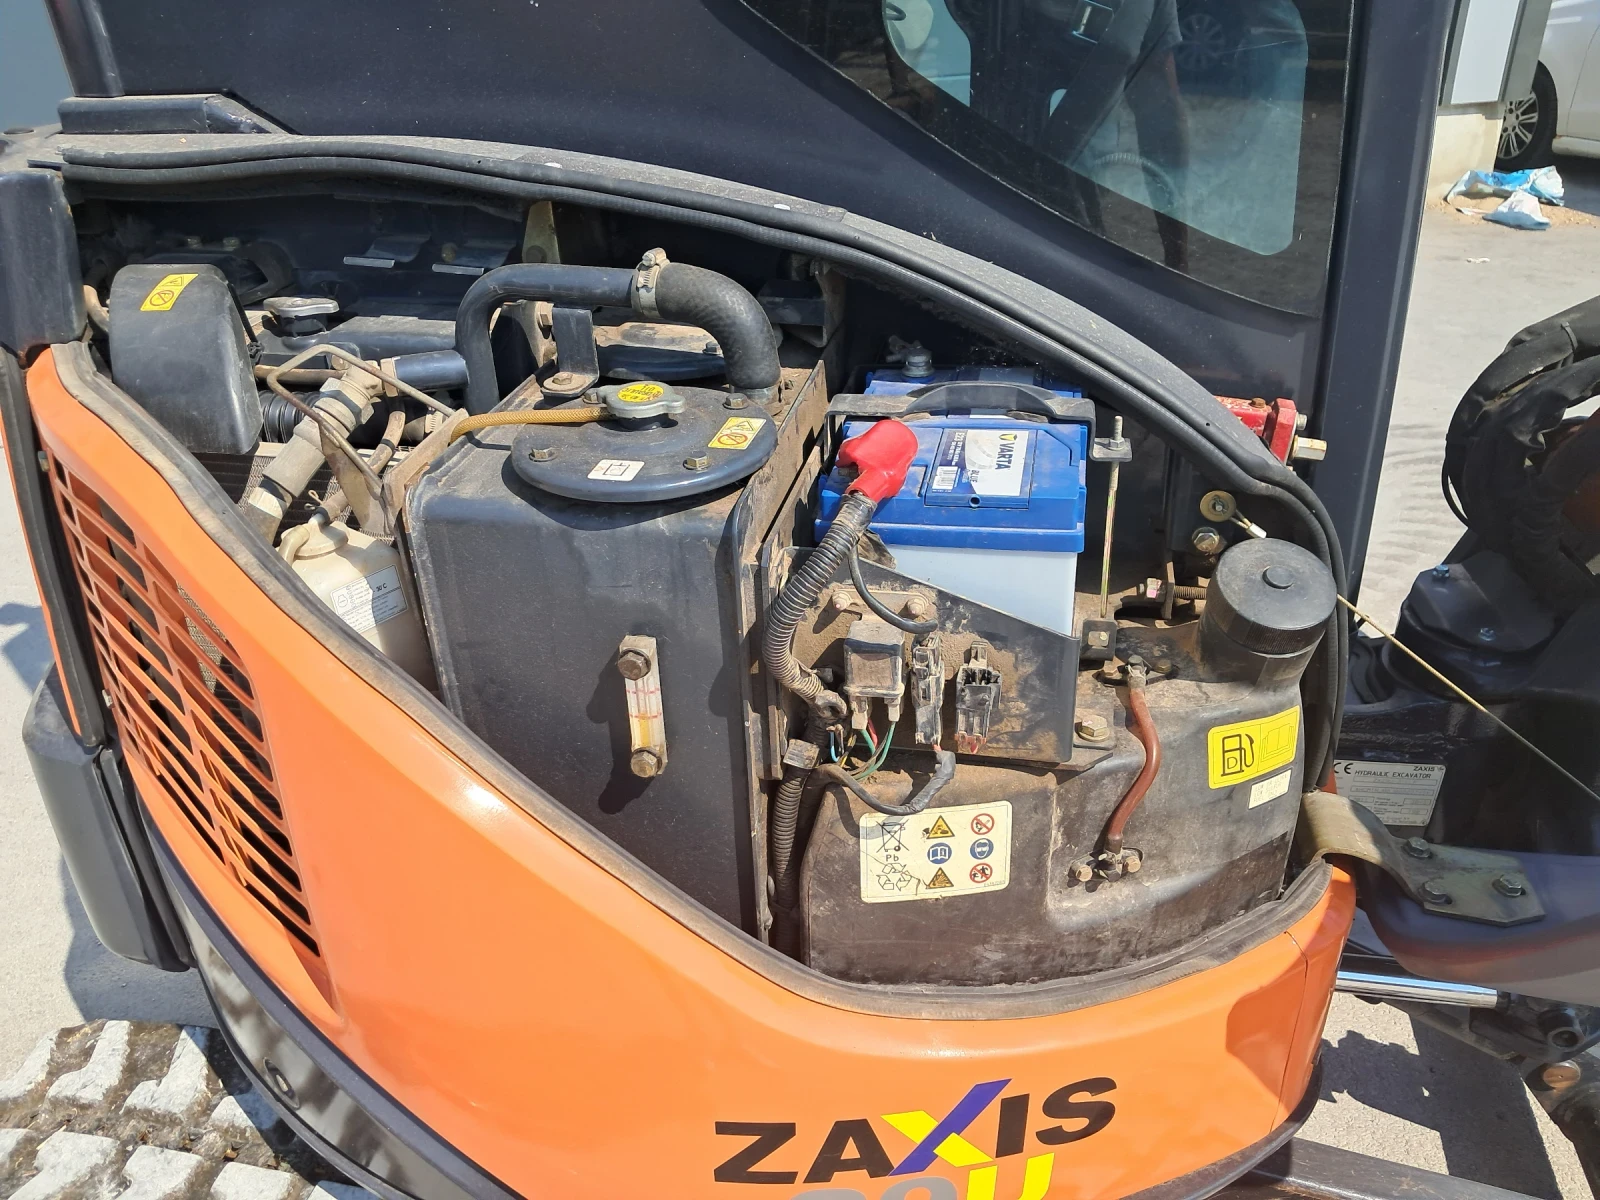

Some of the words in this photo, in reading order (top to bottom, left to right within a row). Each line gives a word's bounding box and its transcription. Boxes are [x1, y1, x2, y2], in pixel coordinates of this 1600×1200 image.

[995, 443, 1014, 470] VARTA
[886, 854, 899, 862] Pb
[714, 1077, 1117, 1184] ZAXIS
